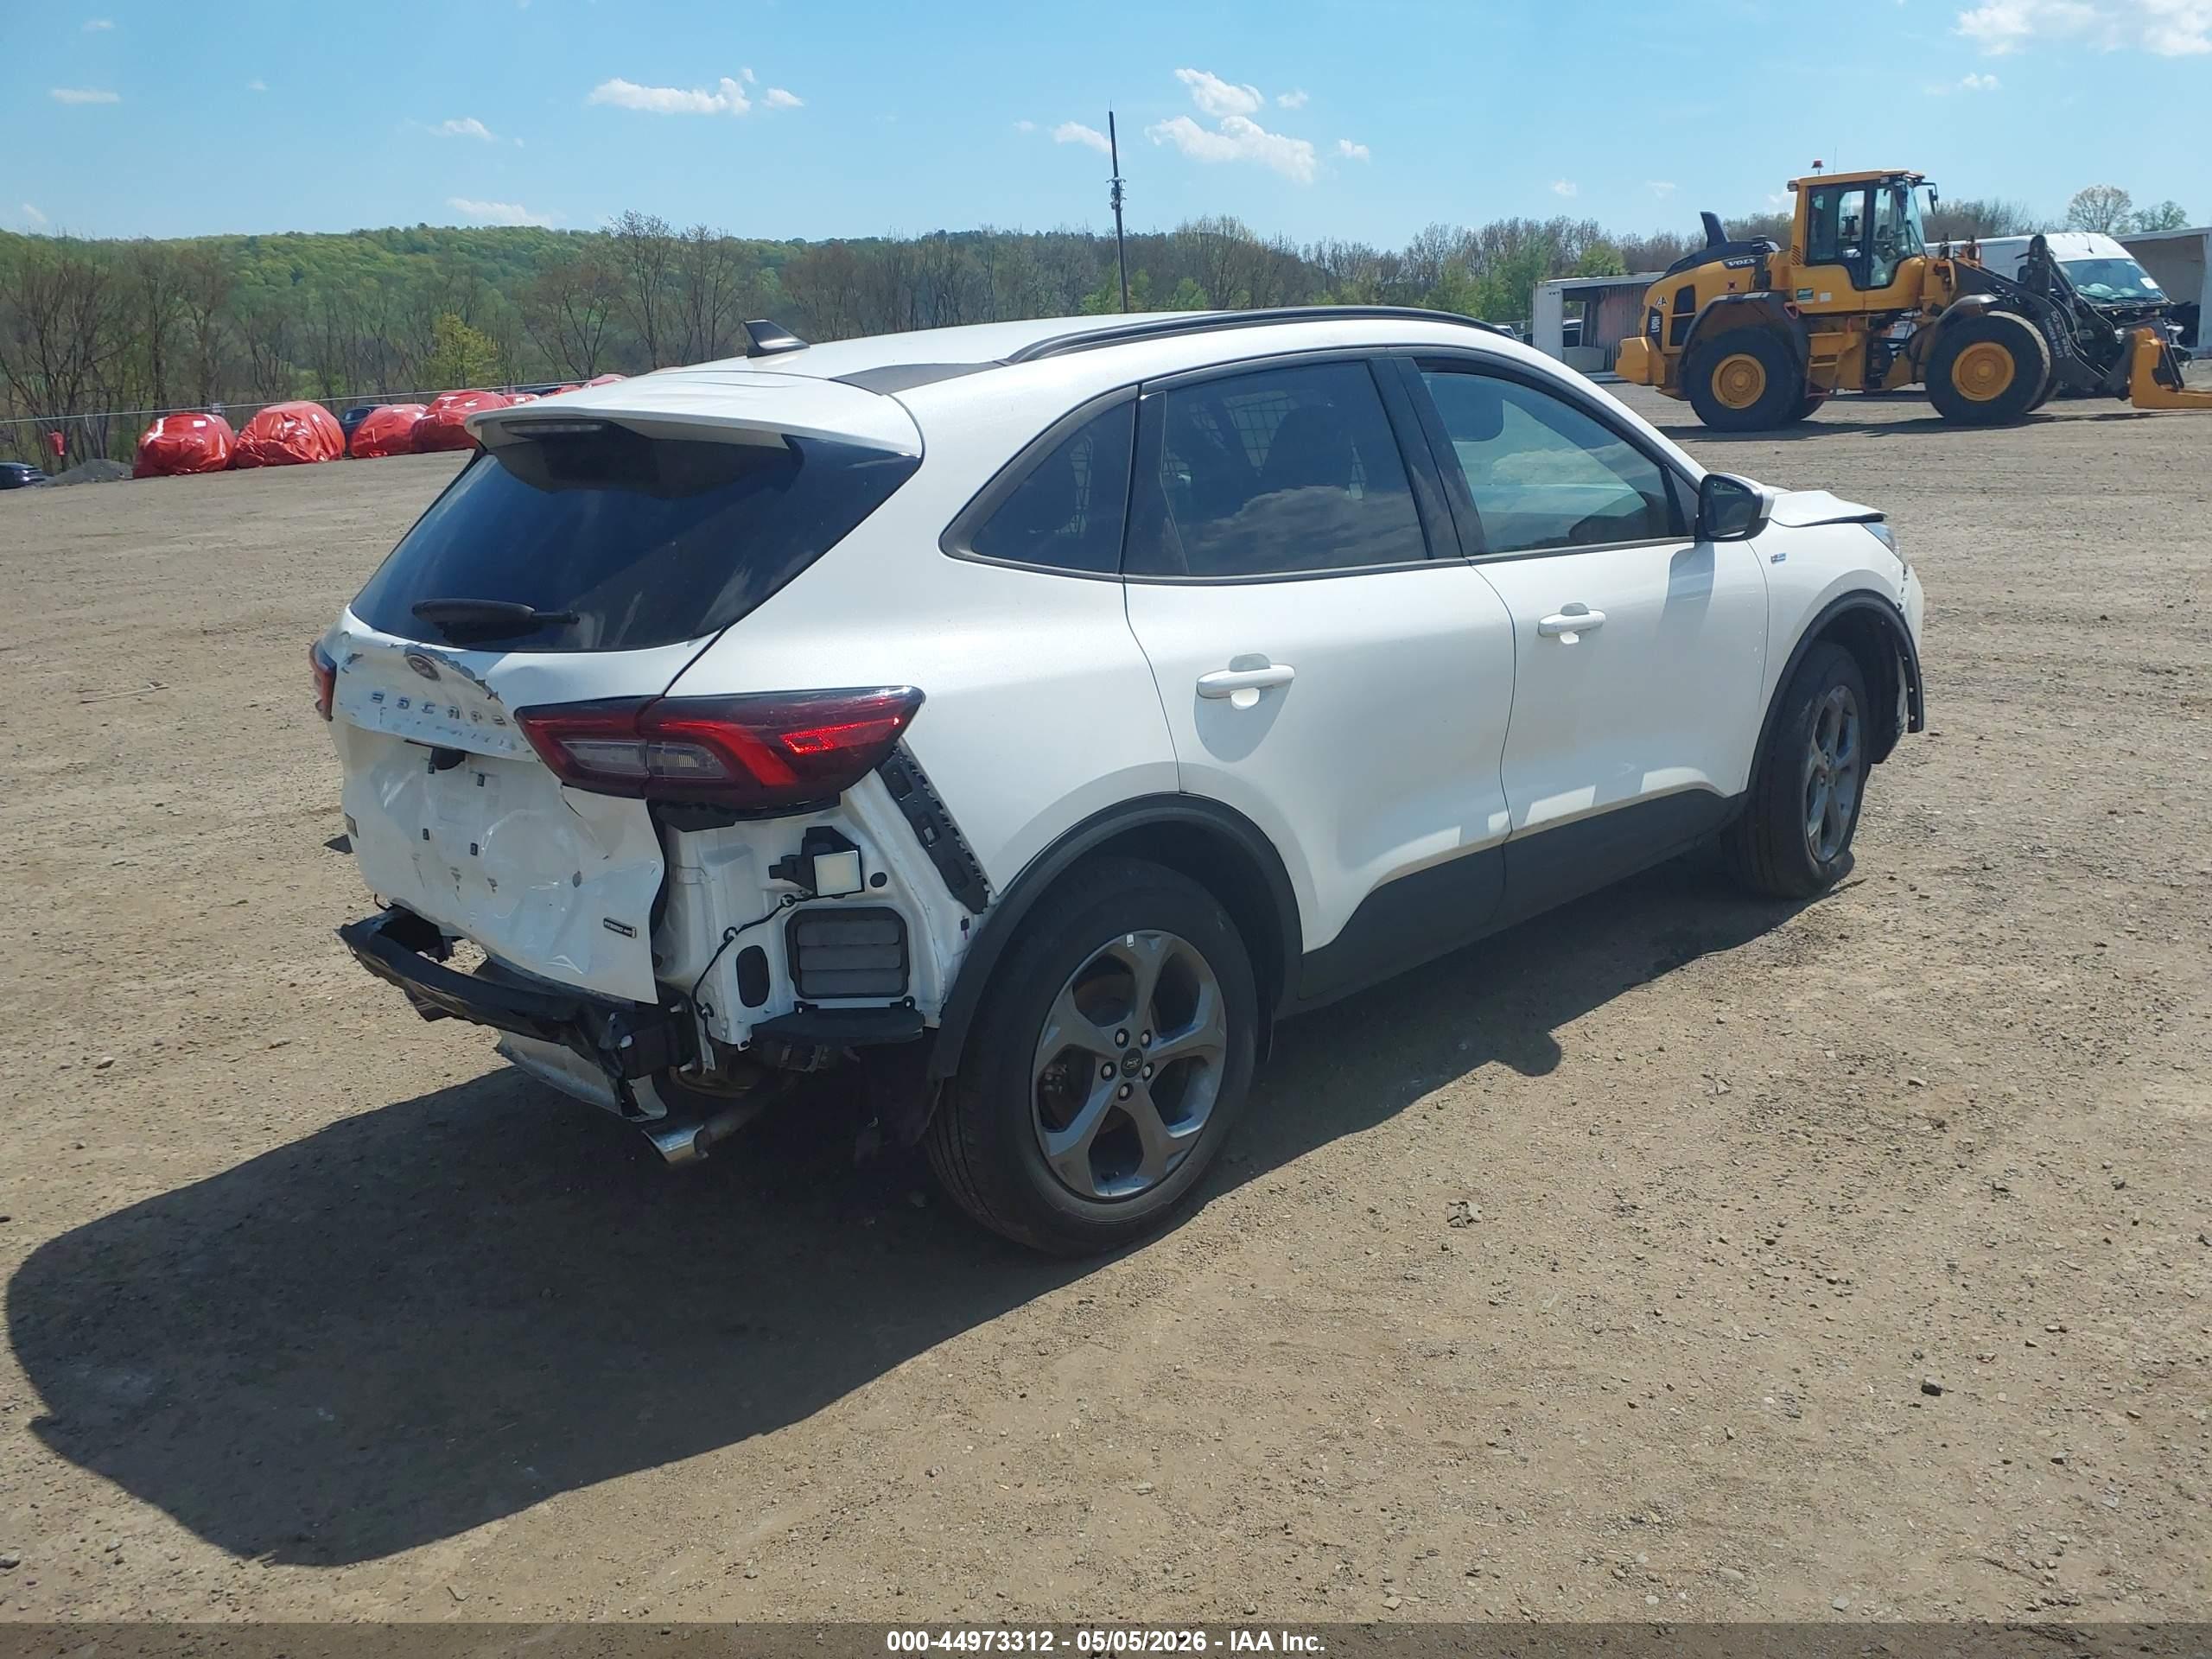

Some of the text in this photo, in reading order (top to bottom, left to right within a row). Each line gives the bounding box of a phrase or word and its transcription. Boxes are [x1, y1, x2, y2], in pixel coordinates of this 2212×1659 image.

[1728, 258, 1757, 267] VOLV
[2050, 310, 2059, 322] DO
[1651, 316, 1660, 333] L90H
[2045, 317, 2056, 340] UNDER
